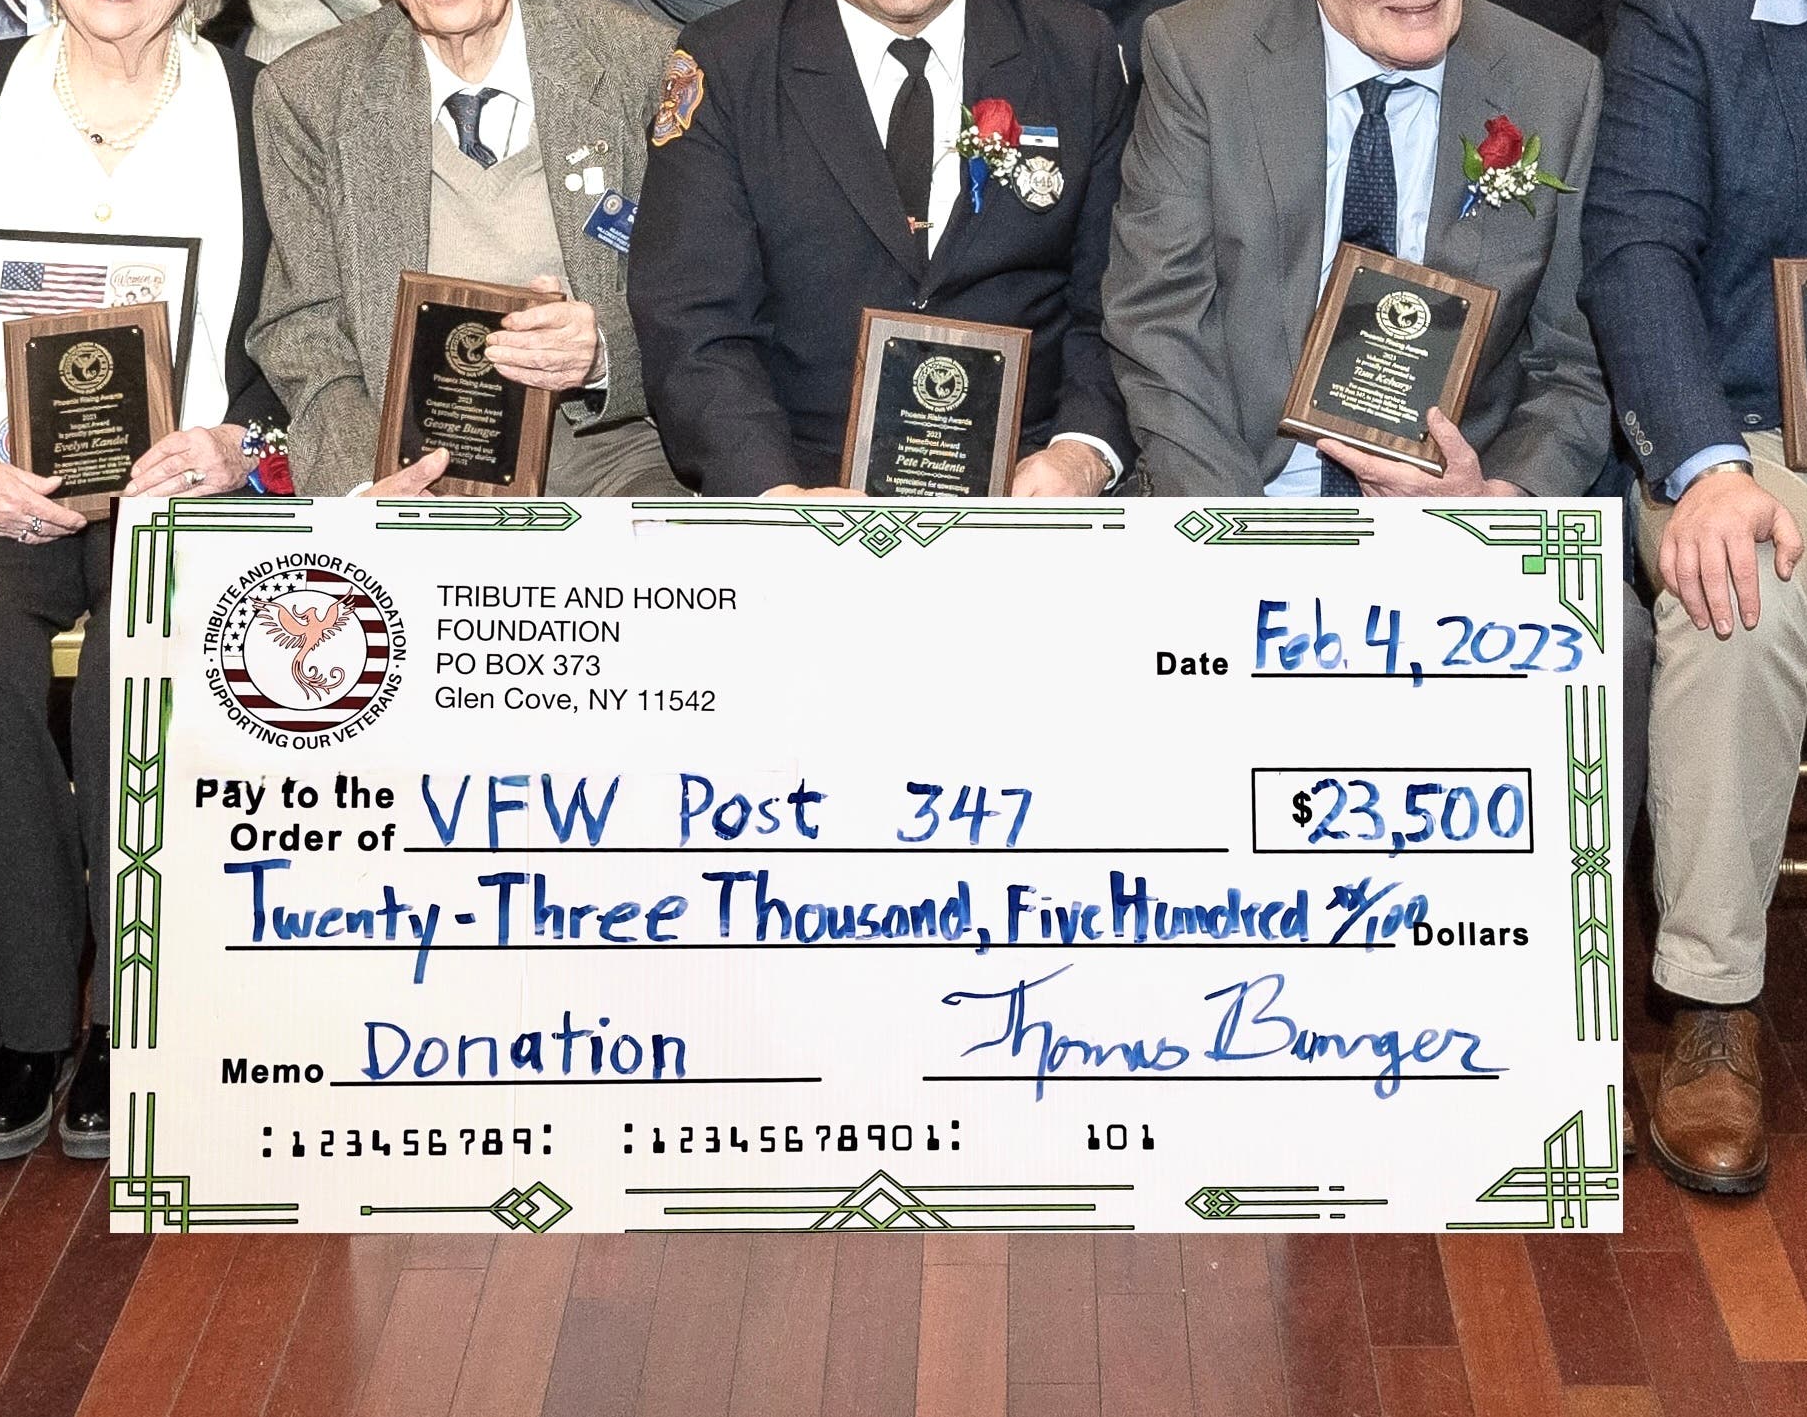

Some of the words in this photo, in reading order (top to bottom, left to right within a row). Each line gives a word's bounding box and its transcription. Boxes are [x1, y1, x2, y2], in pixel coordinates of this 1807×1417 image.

[422, 416, 462, 433] George
[900, 409, 926, 419] Phoenix
[948, 416, 972, 426] Awards
[53, 439, 89, 455] Evelyn
[90, 433, 130, 449] Kandel
[939, 440, 960, 450] Award
[895, 453, 918, 467] Pete
[919, 456, 966, 474] Prudente
[204, 584, 242, 654] TRIBUTE
[239, 562, 273, 589] AND
[276, 553, 343, 571] HONOR
[343, 563, 407, 661] FOUNDATION
[436, 586, 556, 608] TRIBUTE
[564, 587, 624, 609] AND
[634, 588, 737, 610] HONOR
[437, 619, 620, 642] FOUNDATION
[1255, 597, 1350, 672] Feb.
[1365, 605, 1425, 688] 4,
[1436, 614, 1583, 673] 2023
[436, 652, 476, 675] PO
[486, 653, 544, 676] BOX
[553, 654, 601, 676] 373
[1156, 651, 1229, 676] Date
[205, 667, 288, 748] SUPPORTING
[293, 734, 331, 750] OUR
[332, 673, 402, 743] VETERANS
[435, 686, 494, 709] Glen
[504, 687, 578, 714] Cove,
[589, 689, 628, 711] NY
[637, 689, 716, 712] 11542
[195, 776, 266, 812] Pay
[281, 777, 319, 809] to
[334, 775, 395, 809] the
[421, 774, 622, 851] VFW
[679, 773, 826, 846] Post
[897, 783, 1032, 847] 347
[1292, 777, 1525, 857] $23,500
[230, 822, 343, 852] Order
[357, 823, 396, 852] of
[224, 858, 688, 985] Twenty-Three
[701, 869, 990, 954] Thousand,
[1007, 884, 1104, 945] Five
[1108, 870, 1309, 943] Hundred
[1412, 921, 1530, 948] Dollars
[364, 1014, 688, 1081] Donation
[221, 1058, 324, 1084] Memo
